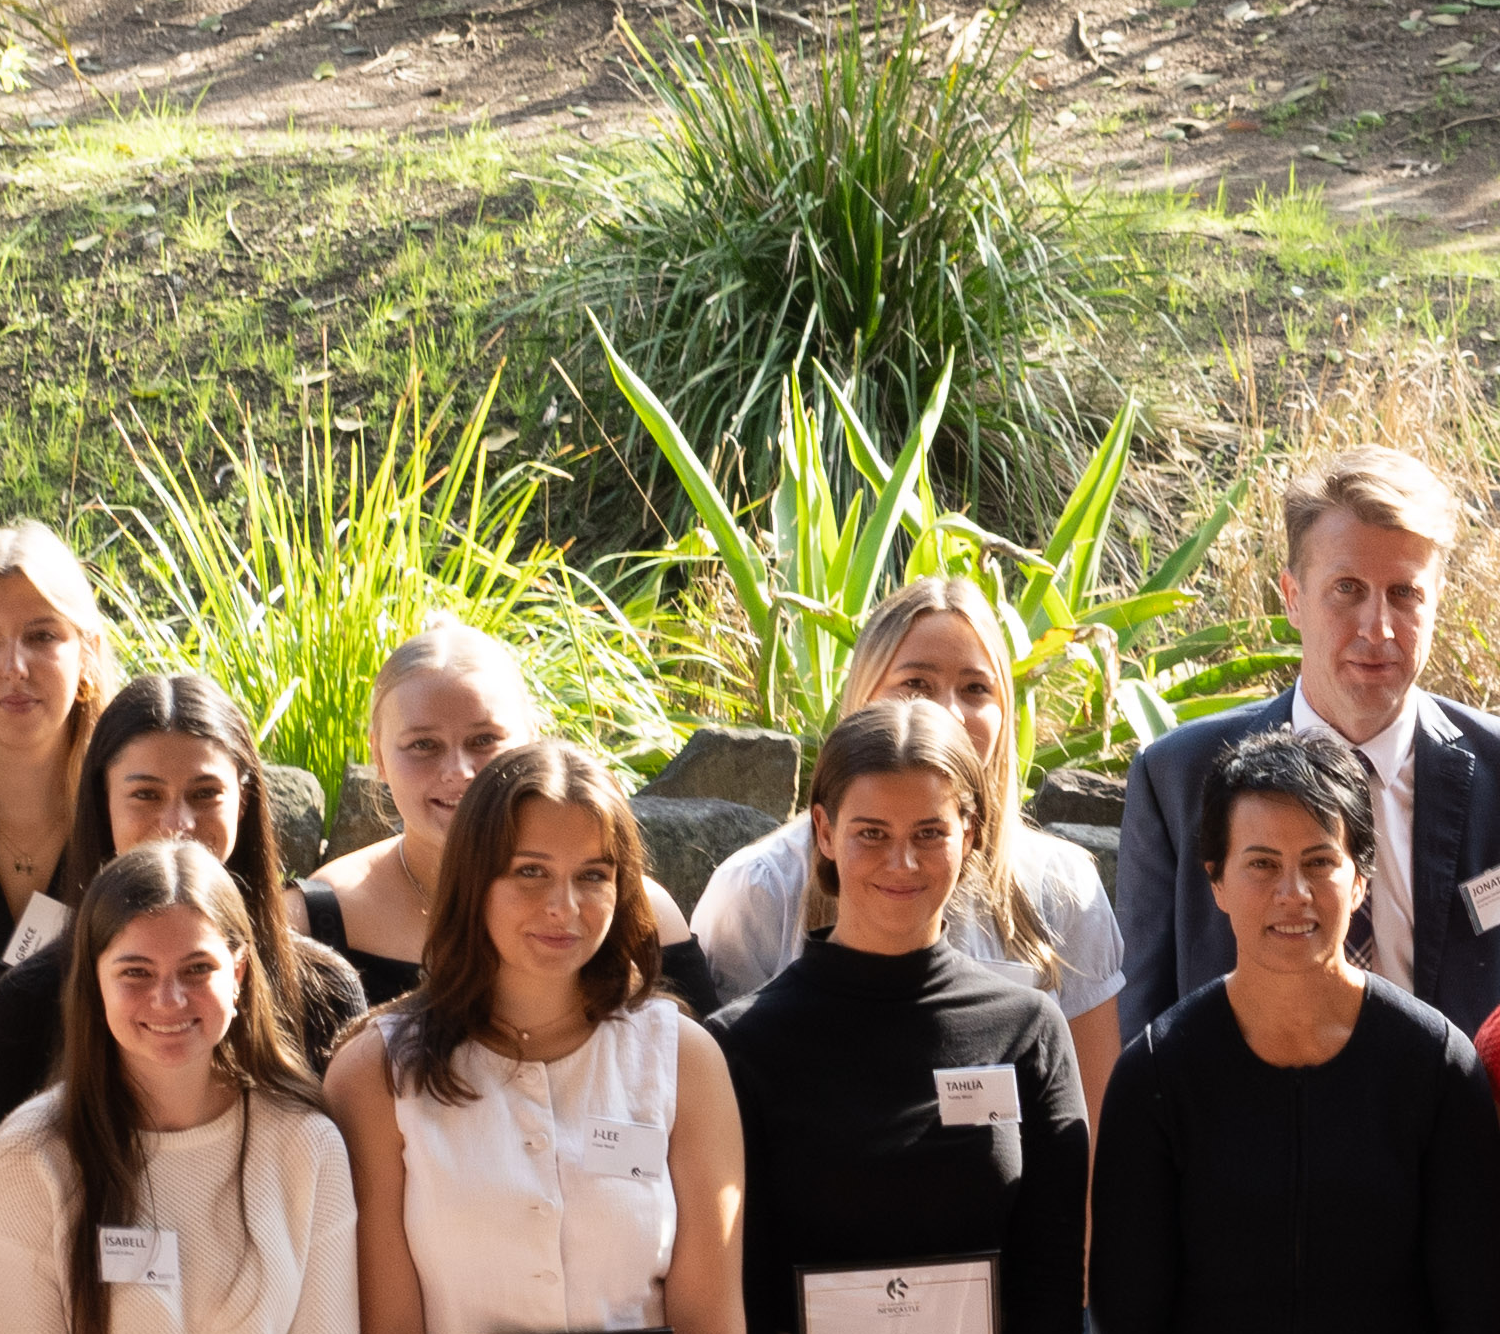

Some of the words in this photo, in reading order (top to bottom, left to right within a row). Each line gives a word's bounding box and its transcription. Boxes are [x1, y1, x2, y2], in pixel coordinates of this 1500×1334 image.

[15, 926, 37, 961] GRACE
[945, 1079, 984, 1091] TAHLIA
[593, 1128, 620, 1142] J-LEE
[105, 1236, 147, 1248] ISABELL
